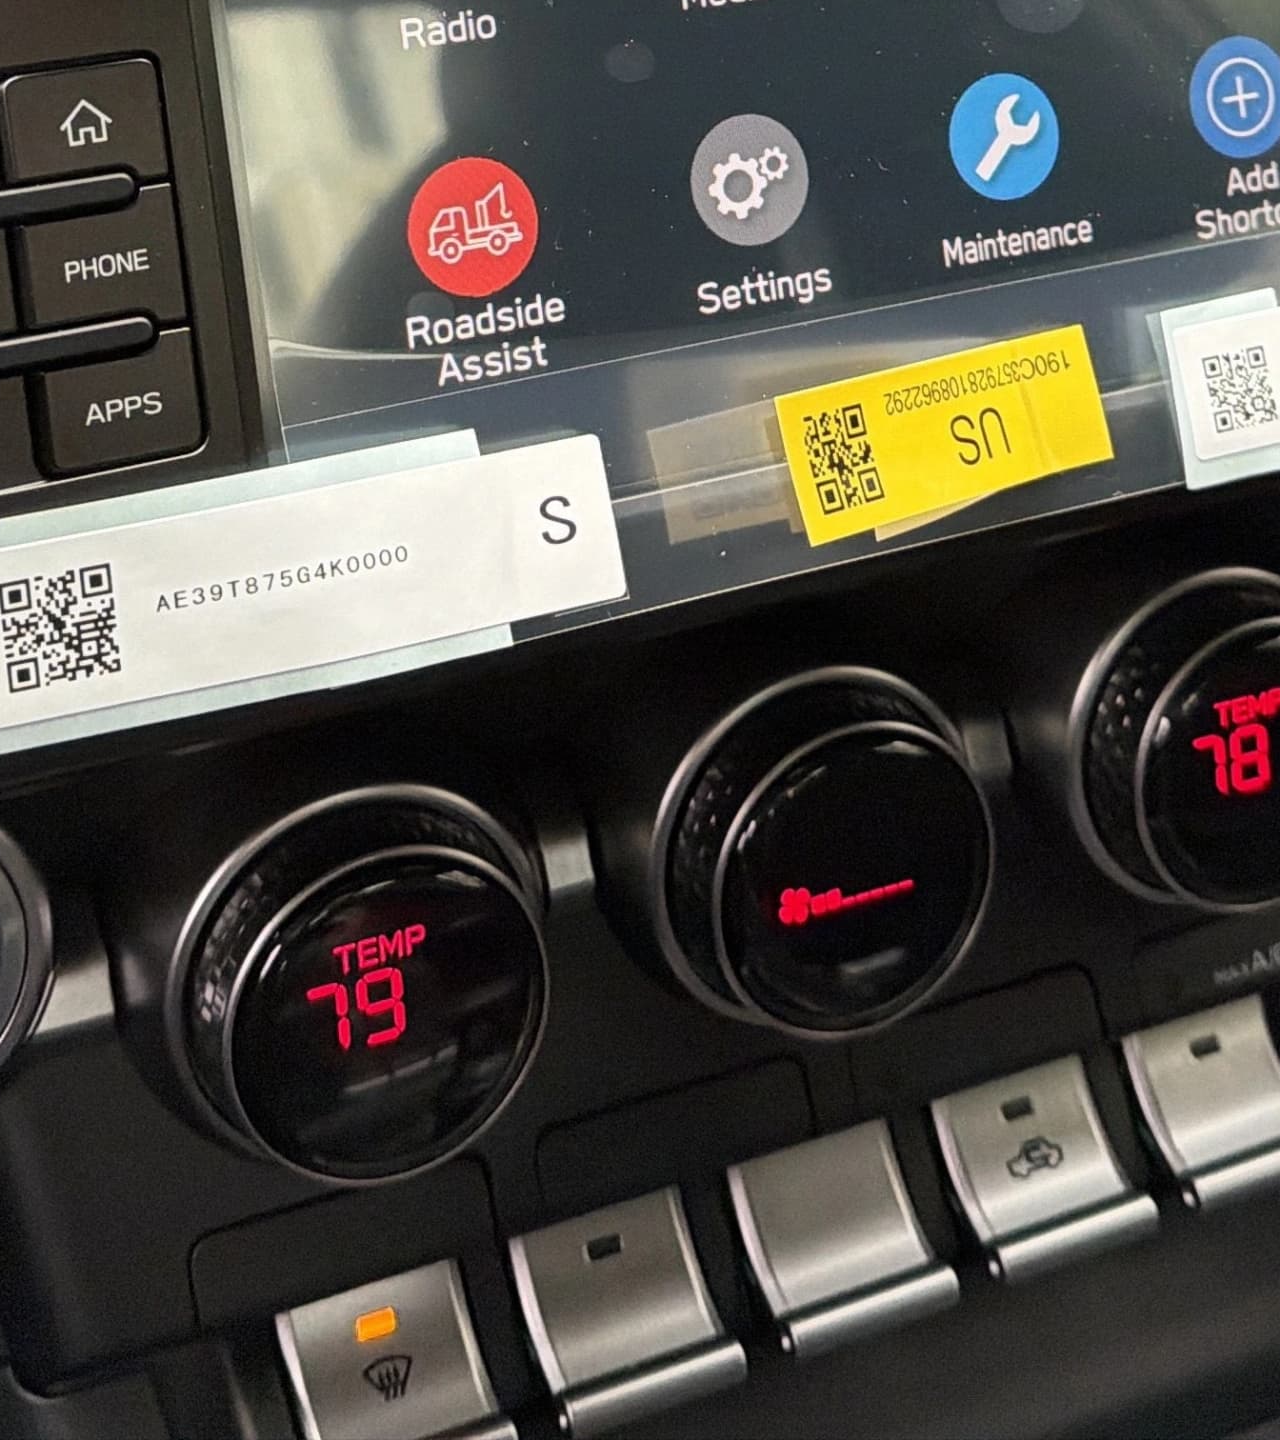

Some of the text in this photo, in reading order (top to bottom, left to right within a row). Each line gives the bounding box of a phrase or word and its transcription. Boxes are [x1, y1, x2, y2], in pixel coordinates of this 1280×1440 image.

[400, 9, 497, 50] Radio
[1227, 161, 1280, 197] Add
[64, 248, 150, 283] PHONE
[942, 219, 1093, 268] Maintenance
[697, 268, 832, 314] Settings
[405, 293, 566, 350] Roadside
[438, 335, 549, 387] Assist
[85, 391, 163, 426] APPS
[950, 407, 1011, 466] US
[539, 495, 578, 546] S
[155, 545, 409, 613] AE39T875G4K0000
[1192, 722, 1271, 794] 78
[332, 924, 426, 975] TEMP
[306, 967, 407, 1050] 79
